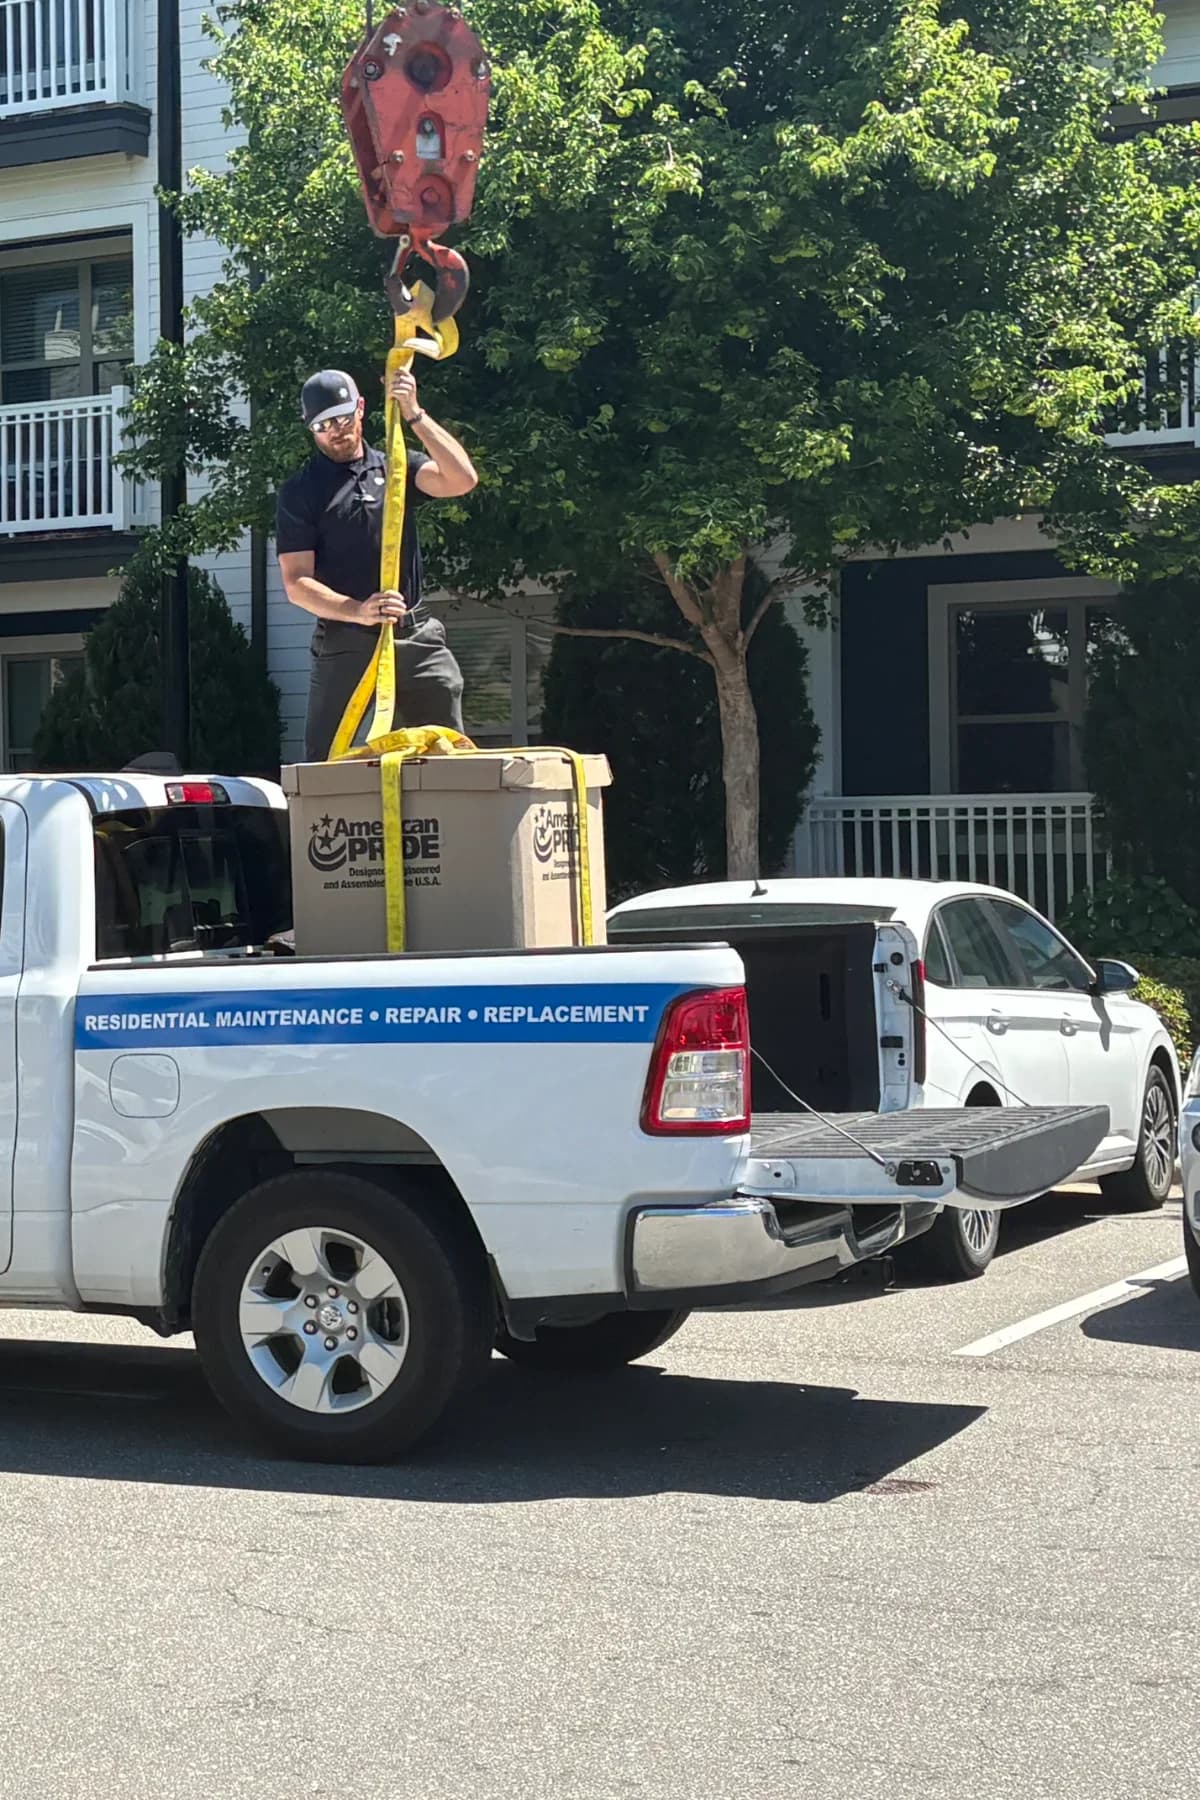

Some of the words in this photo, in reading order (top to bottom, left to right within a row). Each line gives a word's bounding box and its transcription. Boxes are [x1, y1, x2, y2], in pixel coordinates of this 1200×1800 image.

[333, 817, 439, 837] Amecan
[348, 835, 440, 862] PRDE
[85, 1012, 209, 1031] RESIDENTIAL
[215, 1008, 363, 1027] MAINTENANCE
[385, 1006, 461, 1024] REPAIR
[483, 1004, 649, 1024] REPLACEMENT
